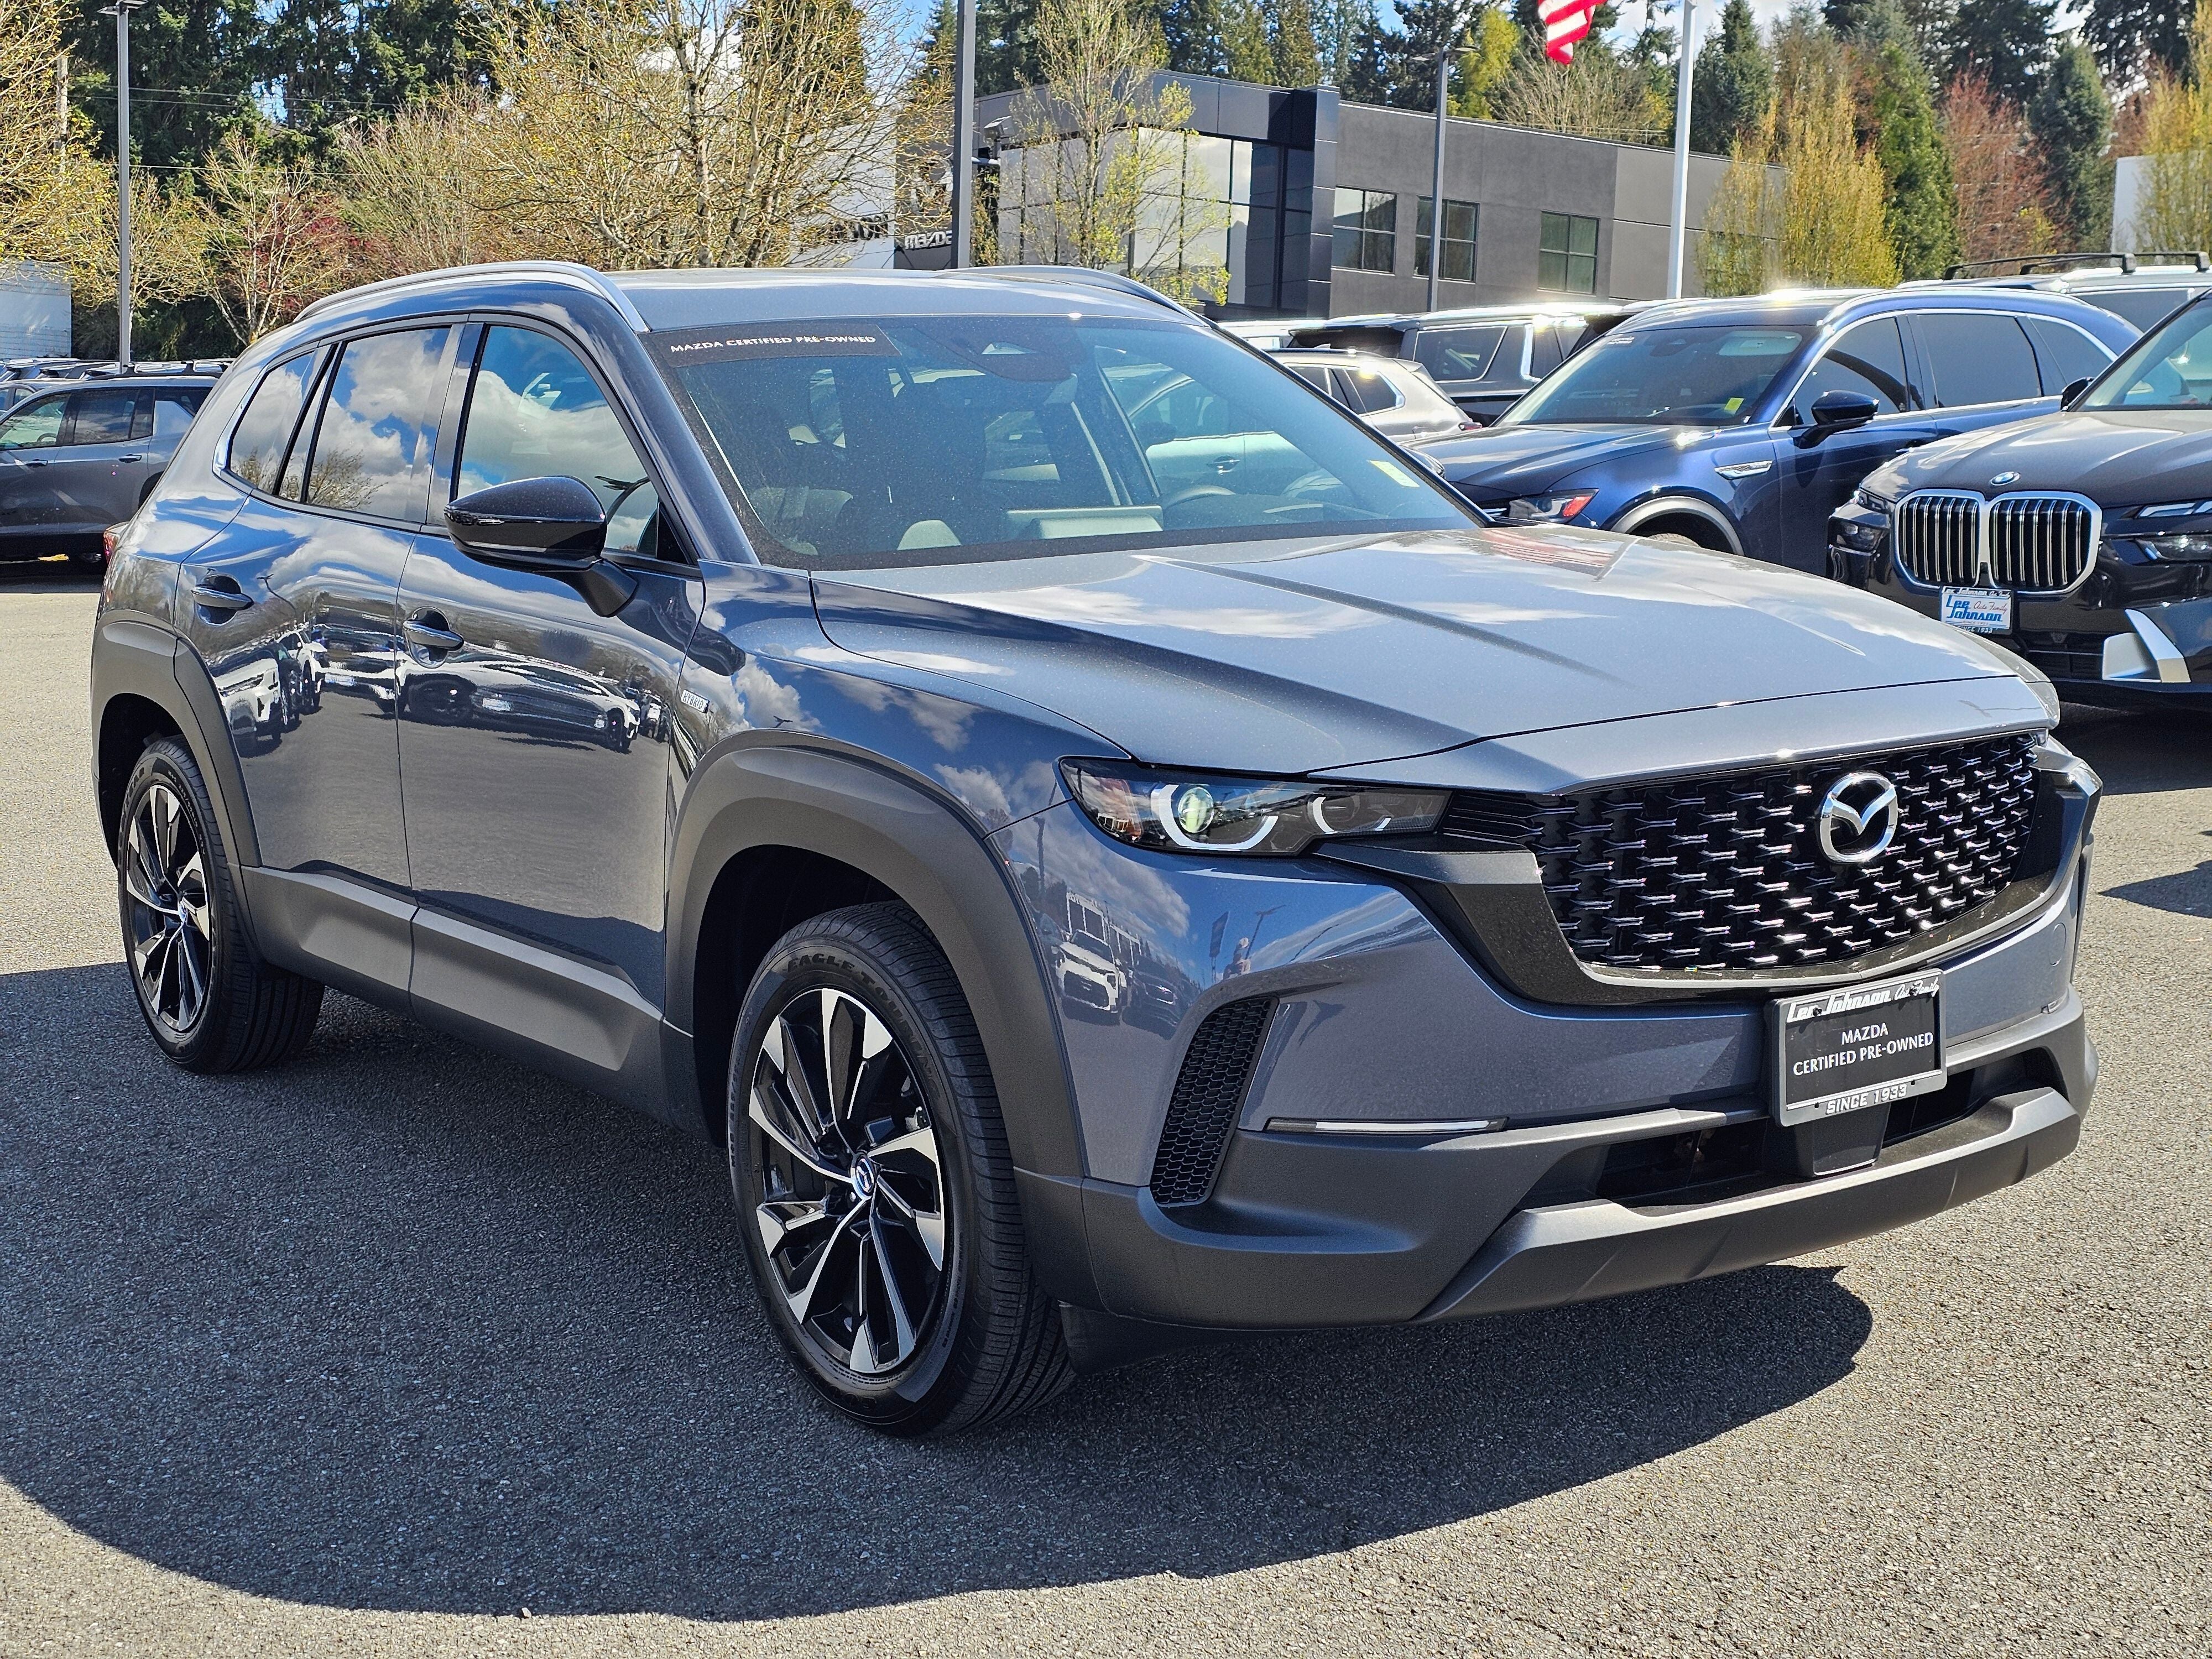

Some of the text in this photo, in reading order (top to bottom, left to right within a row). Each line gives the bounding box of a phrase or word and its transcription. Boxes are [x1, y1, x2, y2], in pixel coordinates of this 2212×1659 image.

[670, 341, 723, 352] MAZDA
[726, 337, 792, 346] CERTIFIED
[1945, 594, 2008, 614] Lee Auto Family
[1947, 604, 2004, 622] Johnson
[682, 691, 705, 710] HYBRID
[787, 953, 855, 974] EAGLE
[1823, 991, 1892, 1015] Johnson
[1912, 977, 1940, 998] Family
[1841, 1022, 1888, 1045] MAZDA
[1793, 1032, 1934, 1076] CERTIFIED PRE-OWNED
[1825, 1084, 1907, 1115] SINCE 1933
